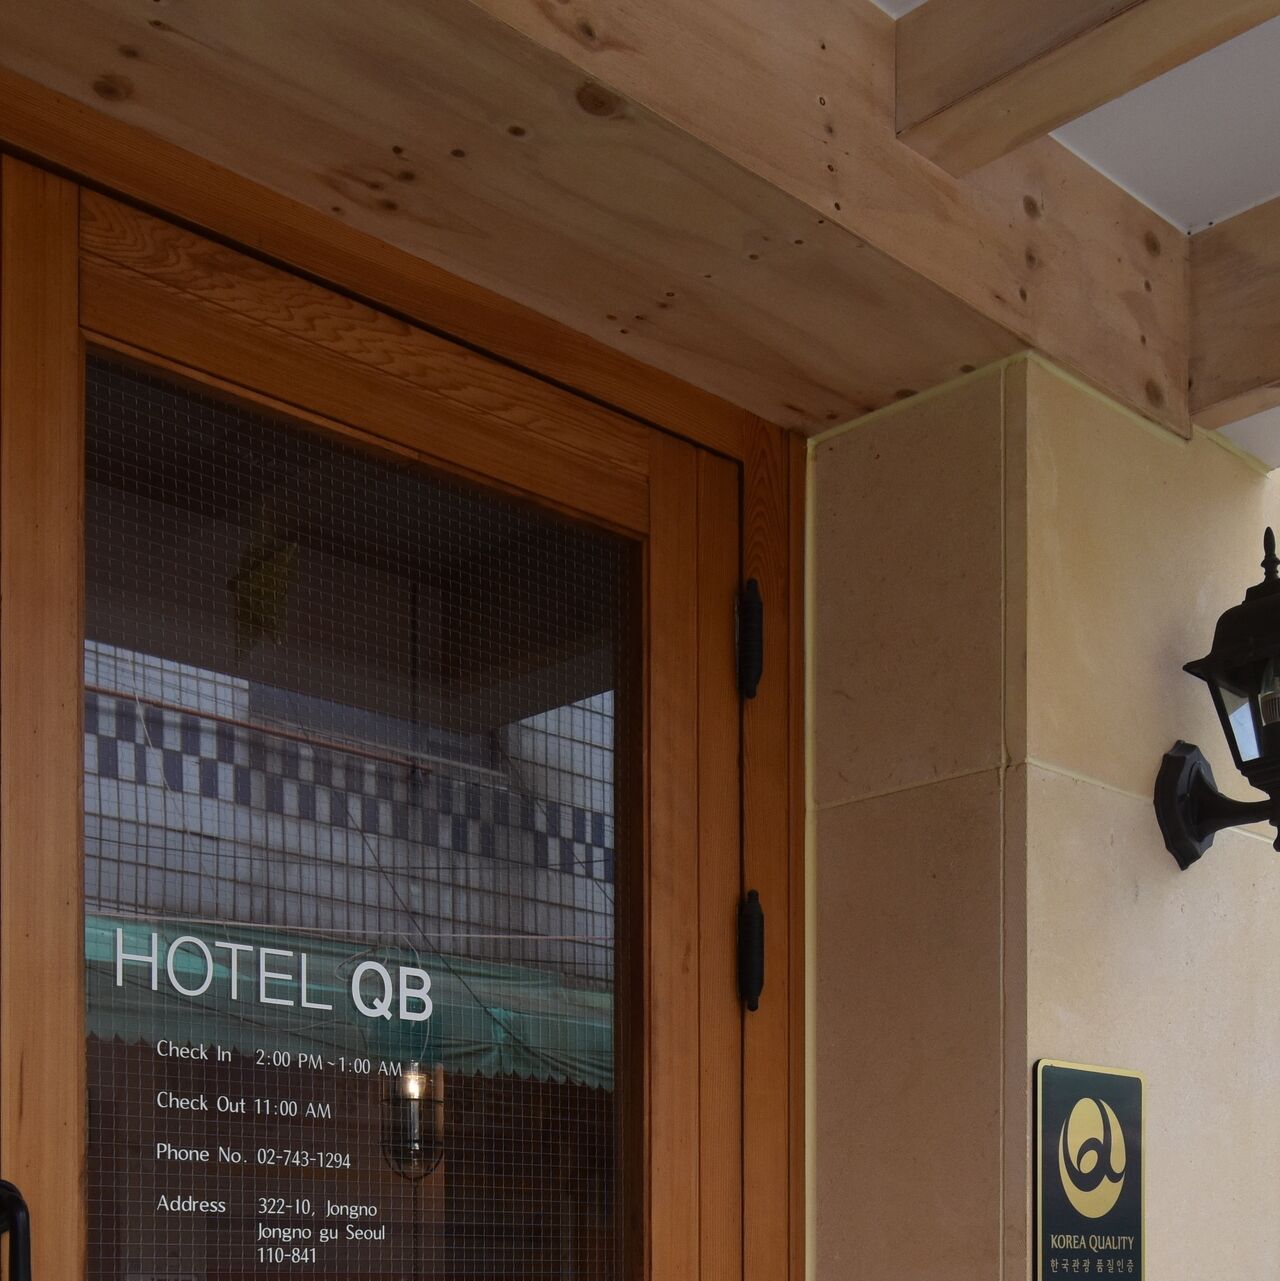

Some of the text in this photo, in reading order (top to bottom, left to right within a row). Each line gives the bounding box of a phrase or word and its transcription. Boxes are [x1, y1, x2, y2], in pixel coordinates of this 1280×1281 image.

[115, 927, 434, 1022] HOTEL QB
[157, 1038, 208, 1060] Check
[217, 1045, 232, 1063] In
[255, 1049, 291, 1067] 2:00
[378, 1060, 403, 1077] AM
[157, 1091, 332, 1119] Check Out 11:00 AM
[156, 1143, 351, 1169] Phone No. 02-743-1294
[156, 1194, 378, 1219] Address 322-10, Jongno
[257, 1222, 386, 1243] Jongno gu Seoul
[1050, 1234, 1135, 1253] KOREA QUALITY
[257, 1247, 317, 1264] 110-841
